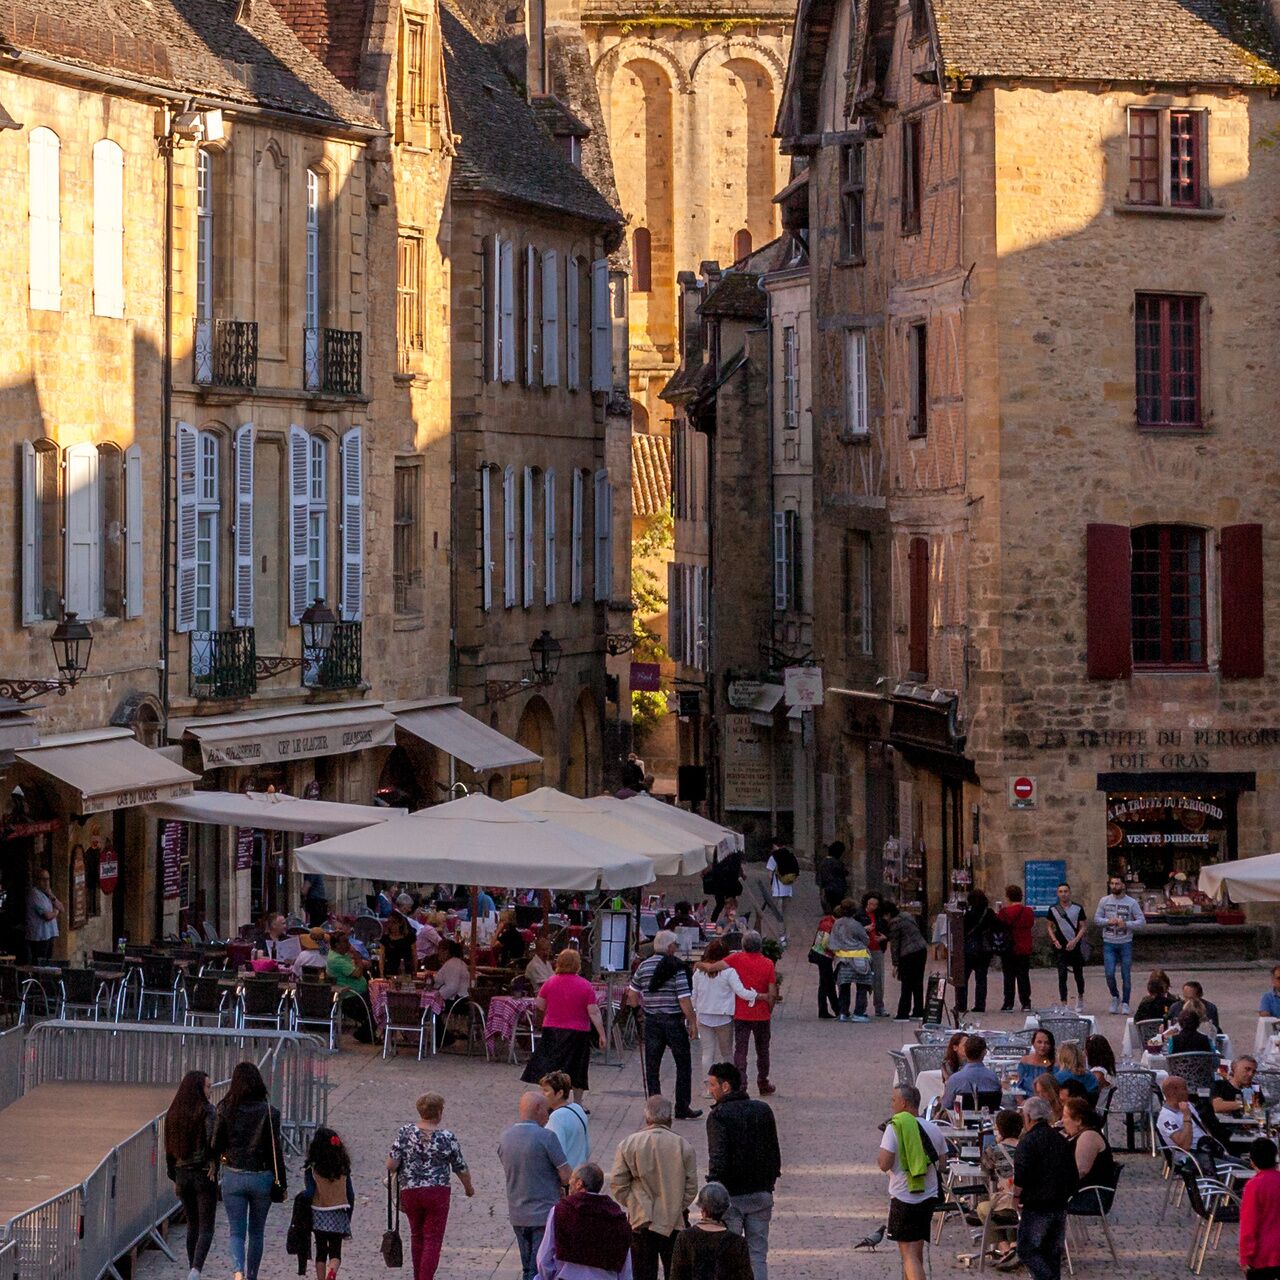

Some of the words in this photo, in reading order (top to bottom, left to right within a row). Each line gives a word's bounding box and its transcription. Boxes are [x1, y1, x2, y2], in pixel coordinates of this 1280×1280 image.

[1077, 729, 1147, 747] TRUFFE
[1157, 729, 1182, 747] DU
[1109, 752, 1148, 769] FOIE
[1161, 752, 1209, 769] GRAS
[1115, 803, 1127, 816] LA
[1128, 798, 1162, 811] TRUFFE
[1164, 798, 1176, 808] DU
[1178, 799, 1224, 820] PERIGORD
[1126, 834, 1161, 844] VENTE
[1163, 833, 1210, 843] DIRECTE
